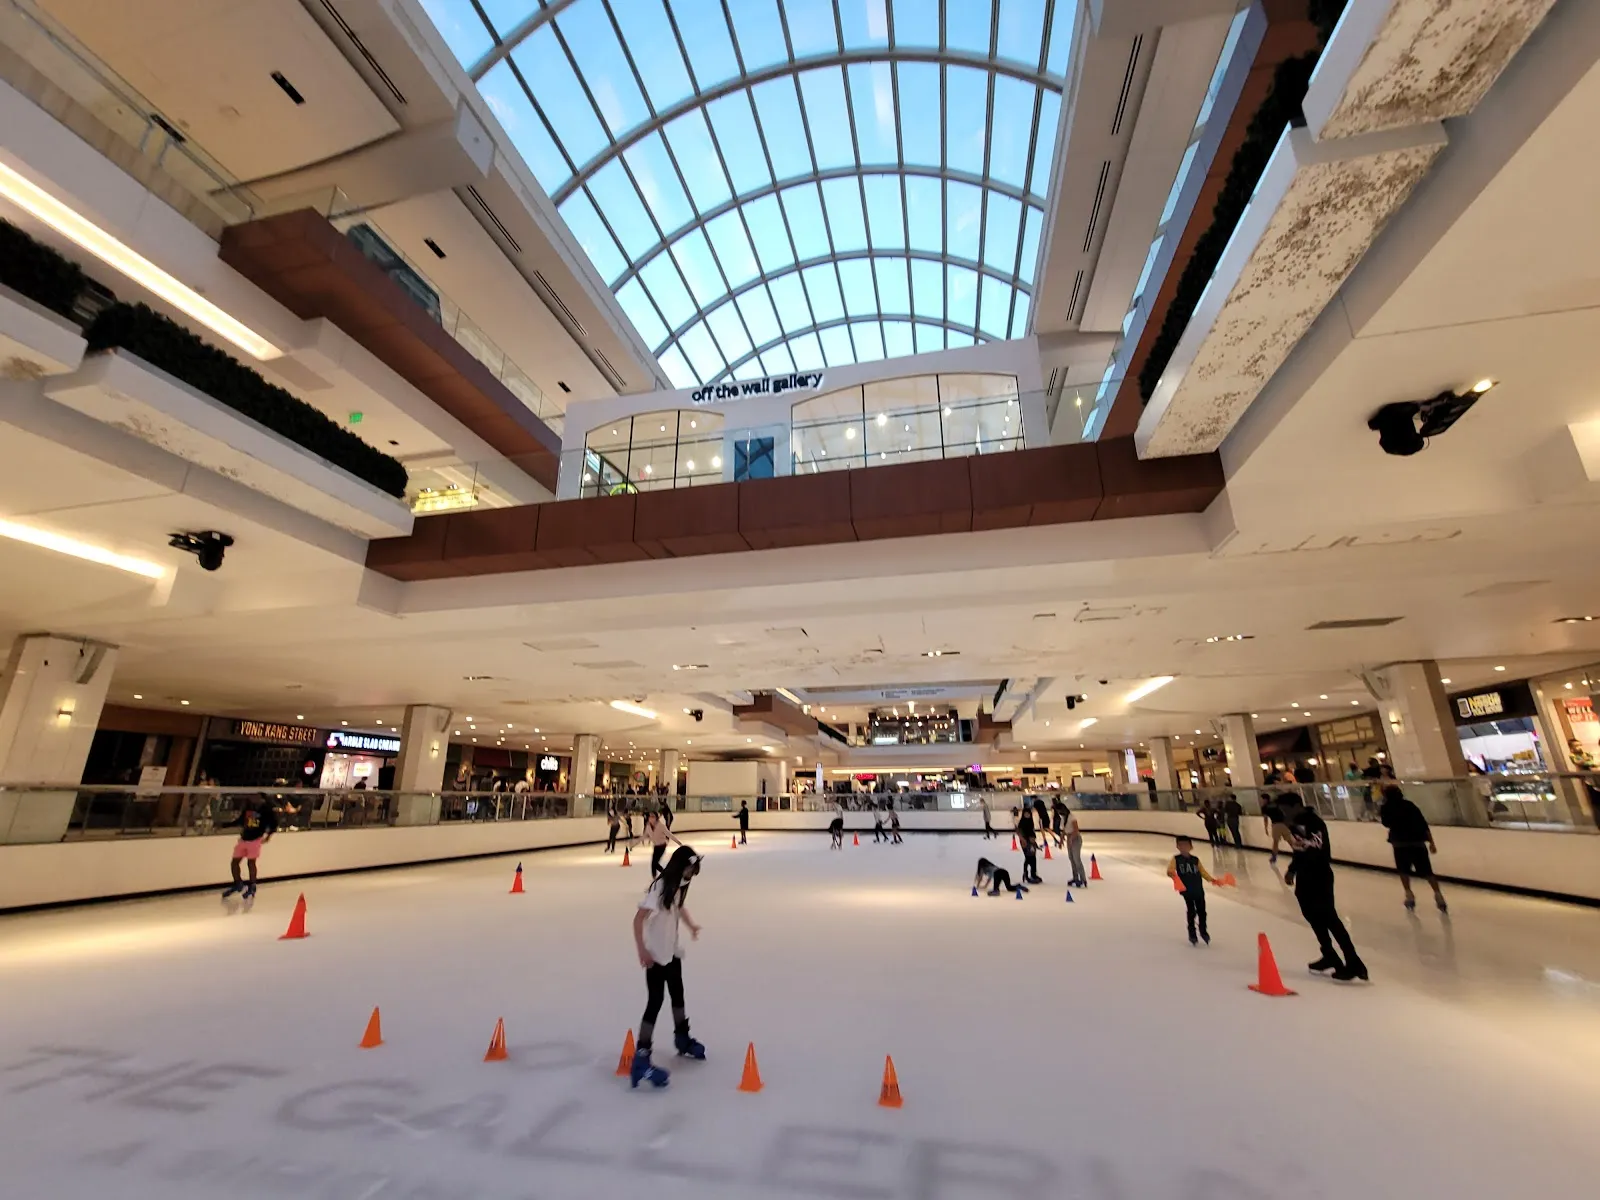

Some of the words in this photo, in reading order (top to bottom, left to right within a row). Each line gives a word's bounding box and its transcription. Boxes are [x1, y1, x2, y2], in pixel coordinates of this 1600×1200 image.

[691, 385, 715, 402] off
[716, 383, 740, 399] the
[741, 378, 770, 395] wall
[772, 372, 823, 393] gallery
[240, 721, 264, 736] YONG
[265, 724, 288, 739] KANG
[288, 726, 317, 742] STREET
